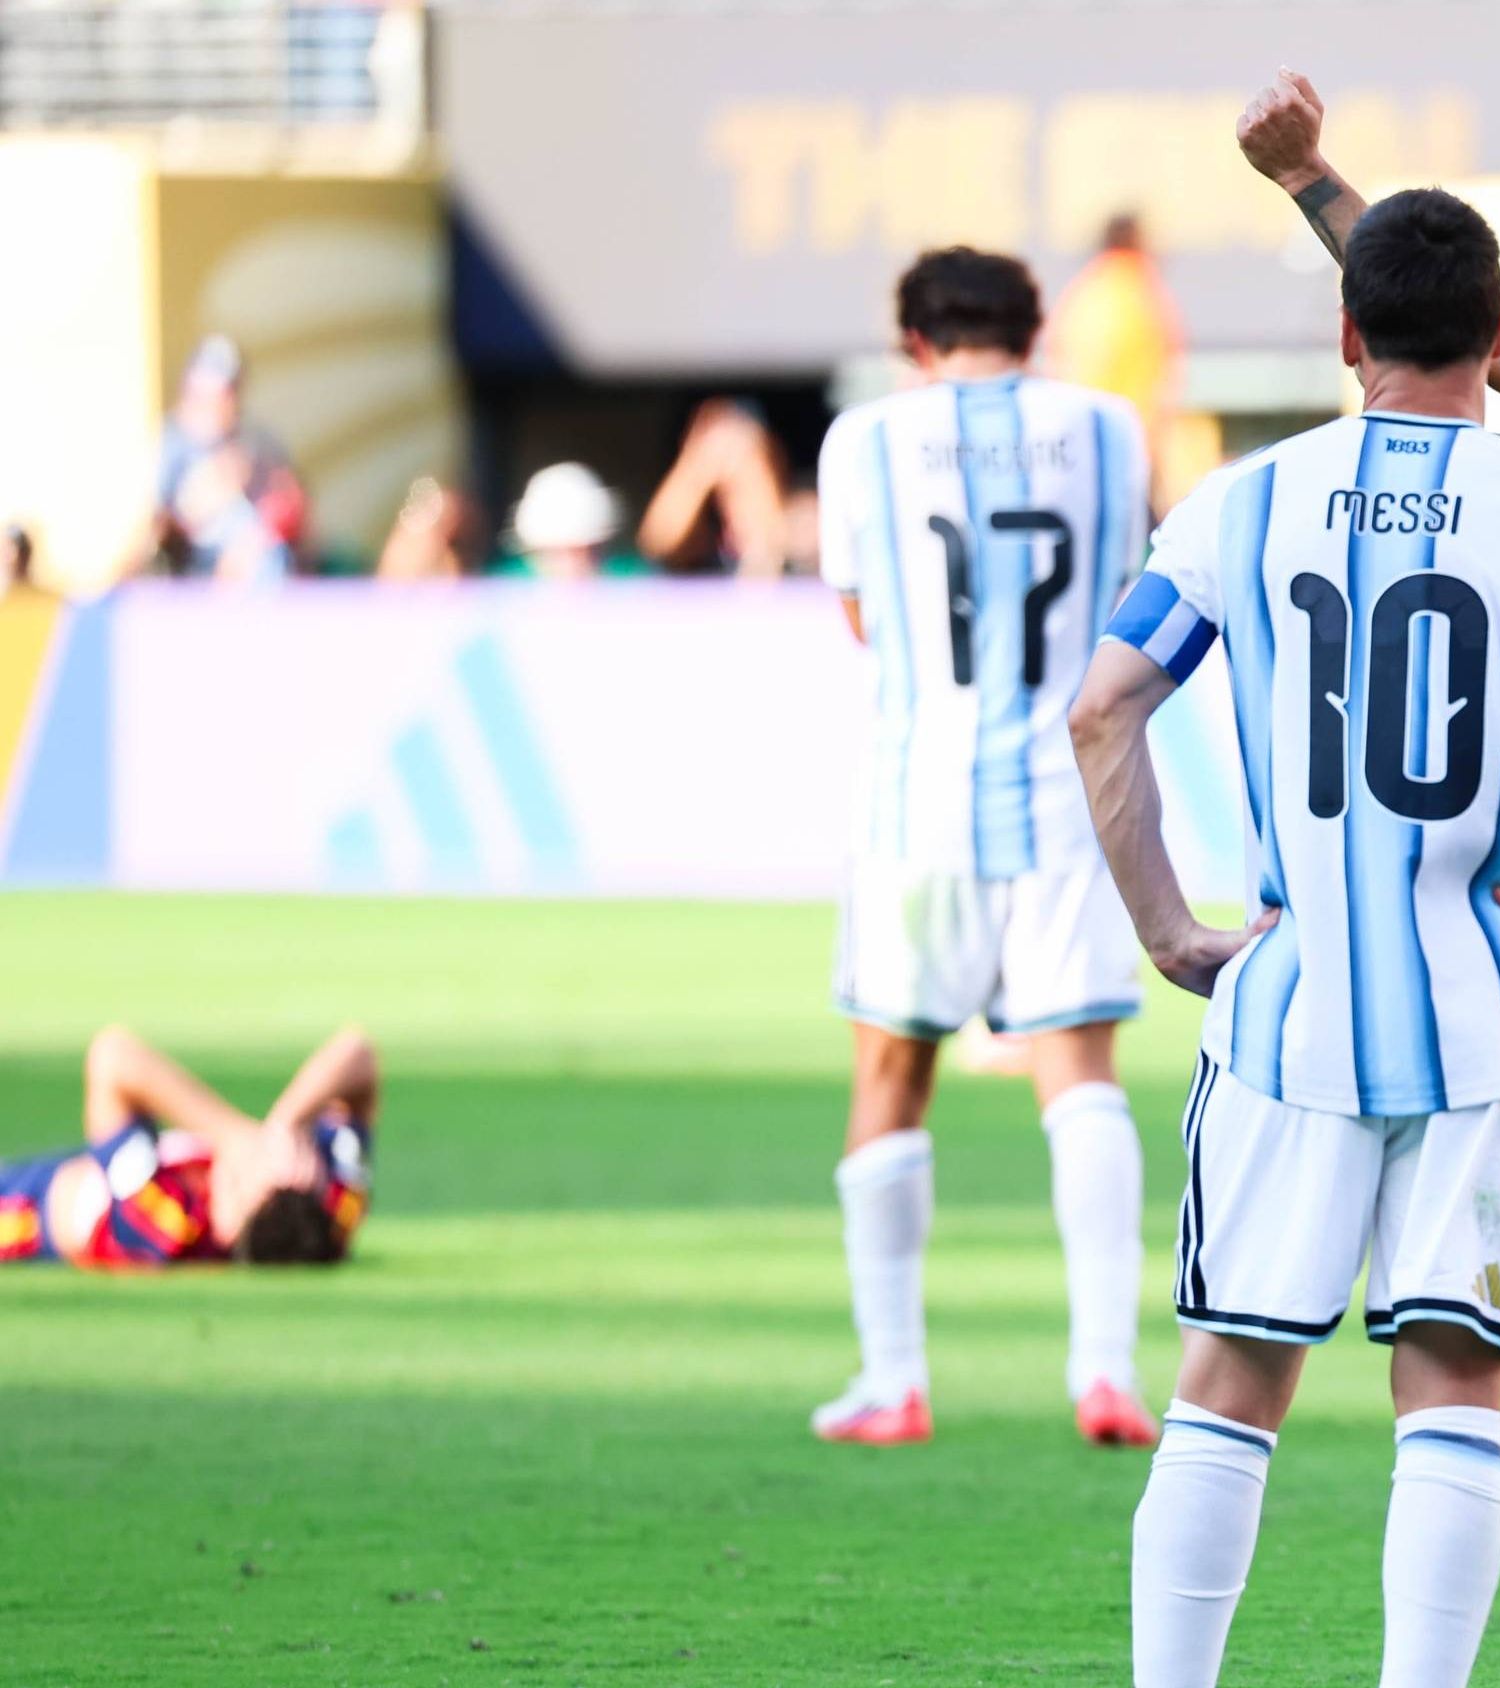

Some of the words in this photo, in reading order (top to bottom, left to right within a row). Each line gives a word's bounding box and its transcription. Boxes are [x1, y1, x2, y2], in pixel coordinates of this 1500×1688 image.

[927, 510, 1074, 686] 17
[1326, 490, 1462, 535] MESSI
[1289, 571, 1489, 821] 10
